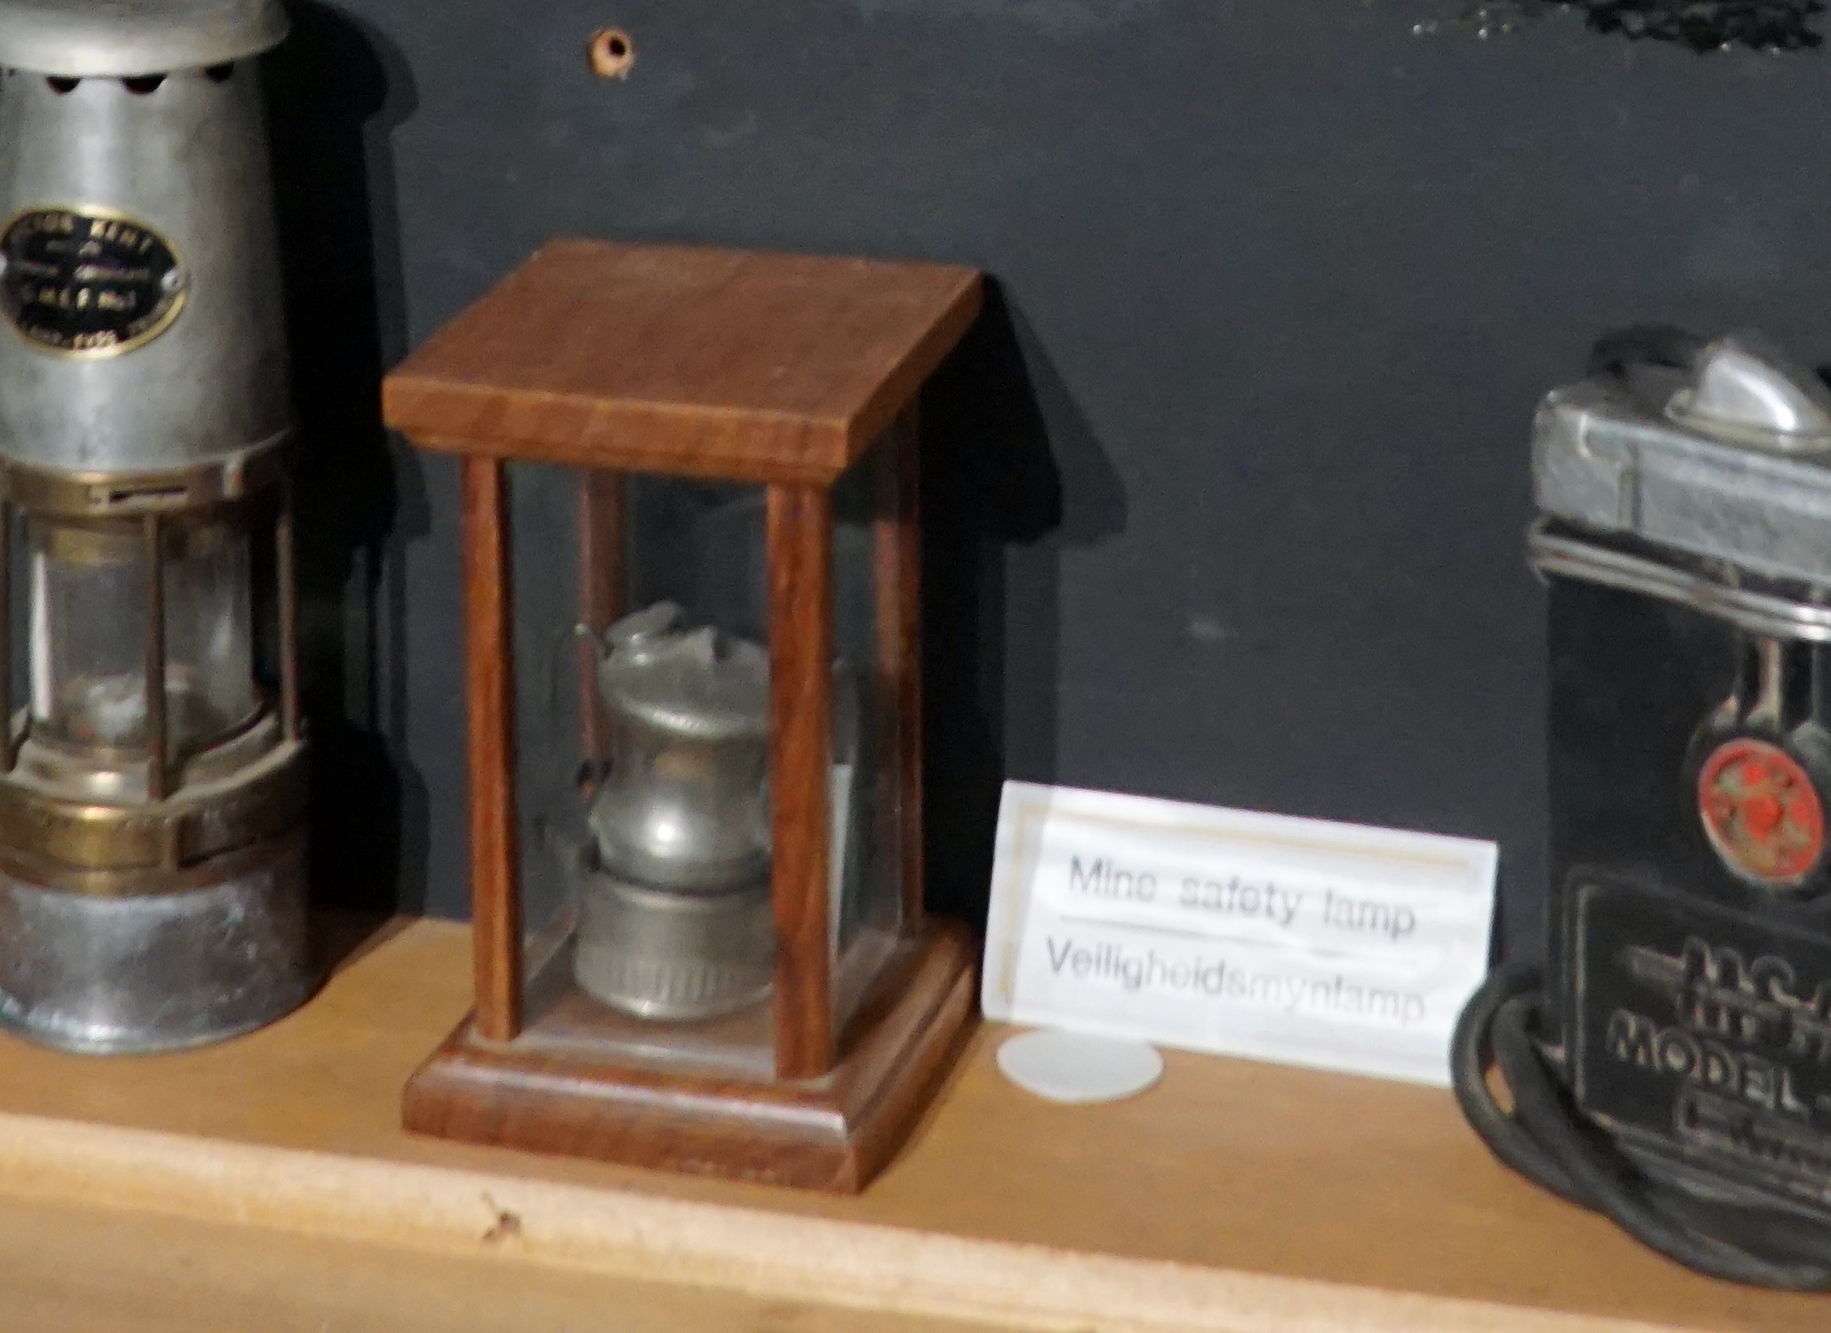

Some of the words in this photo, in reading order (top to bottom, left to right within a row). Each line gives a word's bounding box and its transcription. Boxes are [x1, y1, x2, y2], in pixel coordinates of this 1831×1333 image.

[1068, 855, 1158, 903] Mine
[1178, 874, 1303, 927] safety
[1323, 889, 1417, 941] lamp
